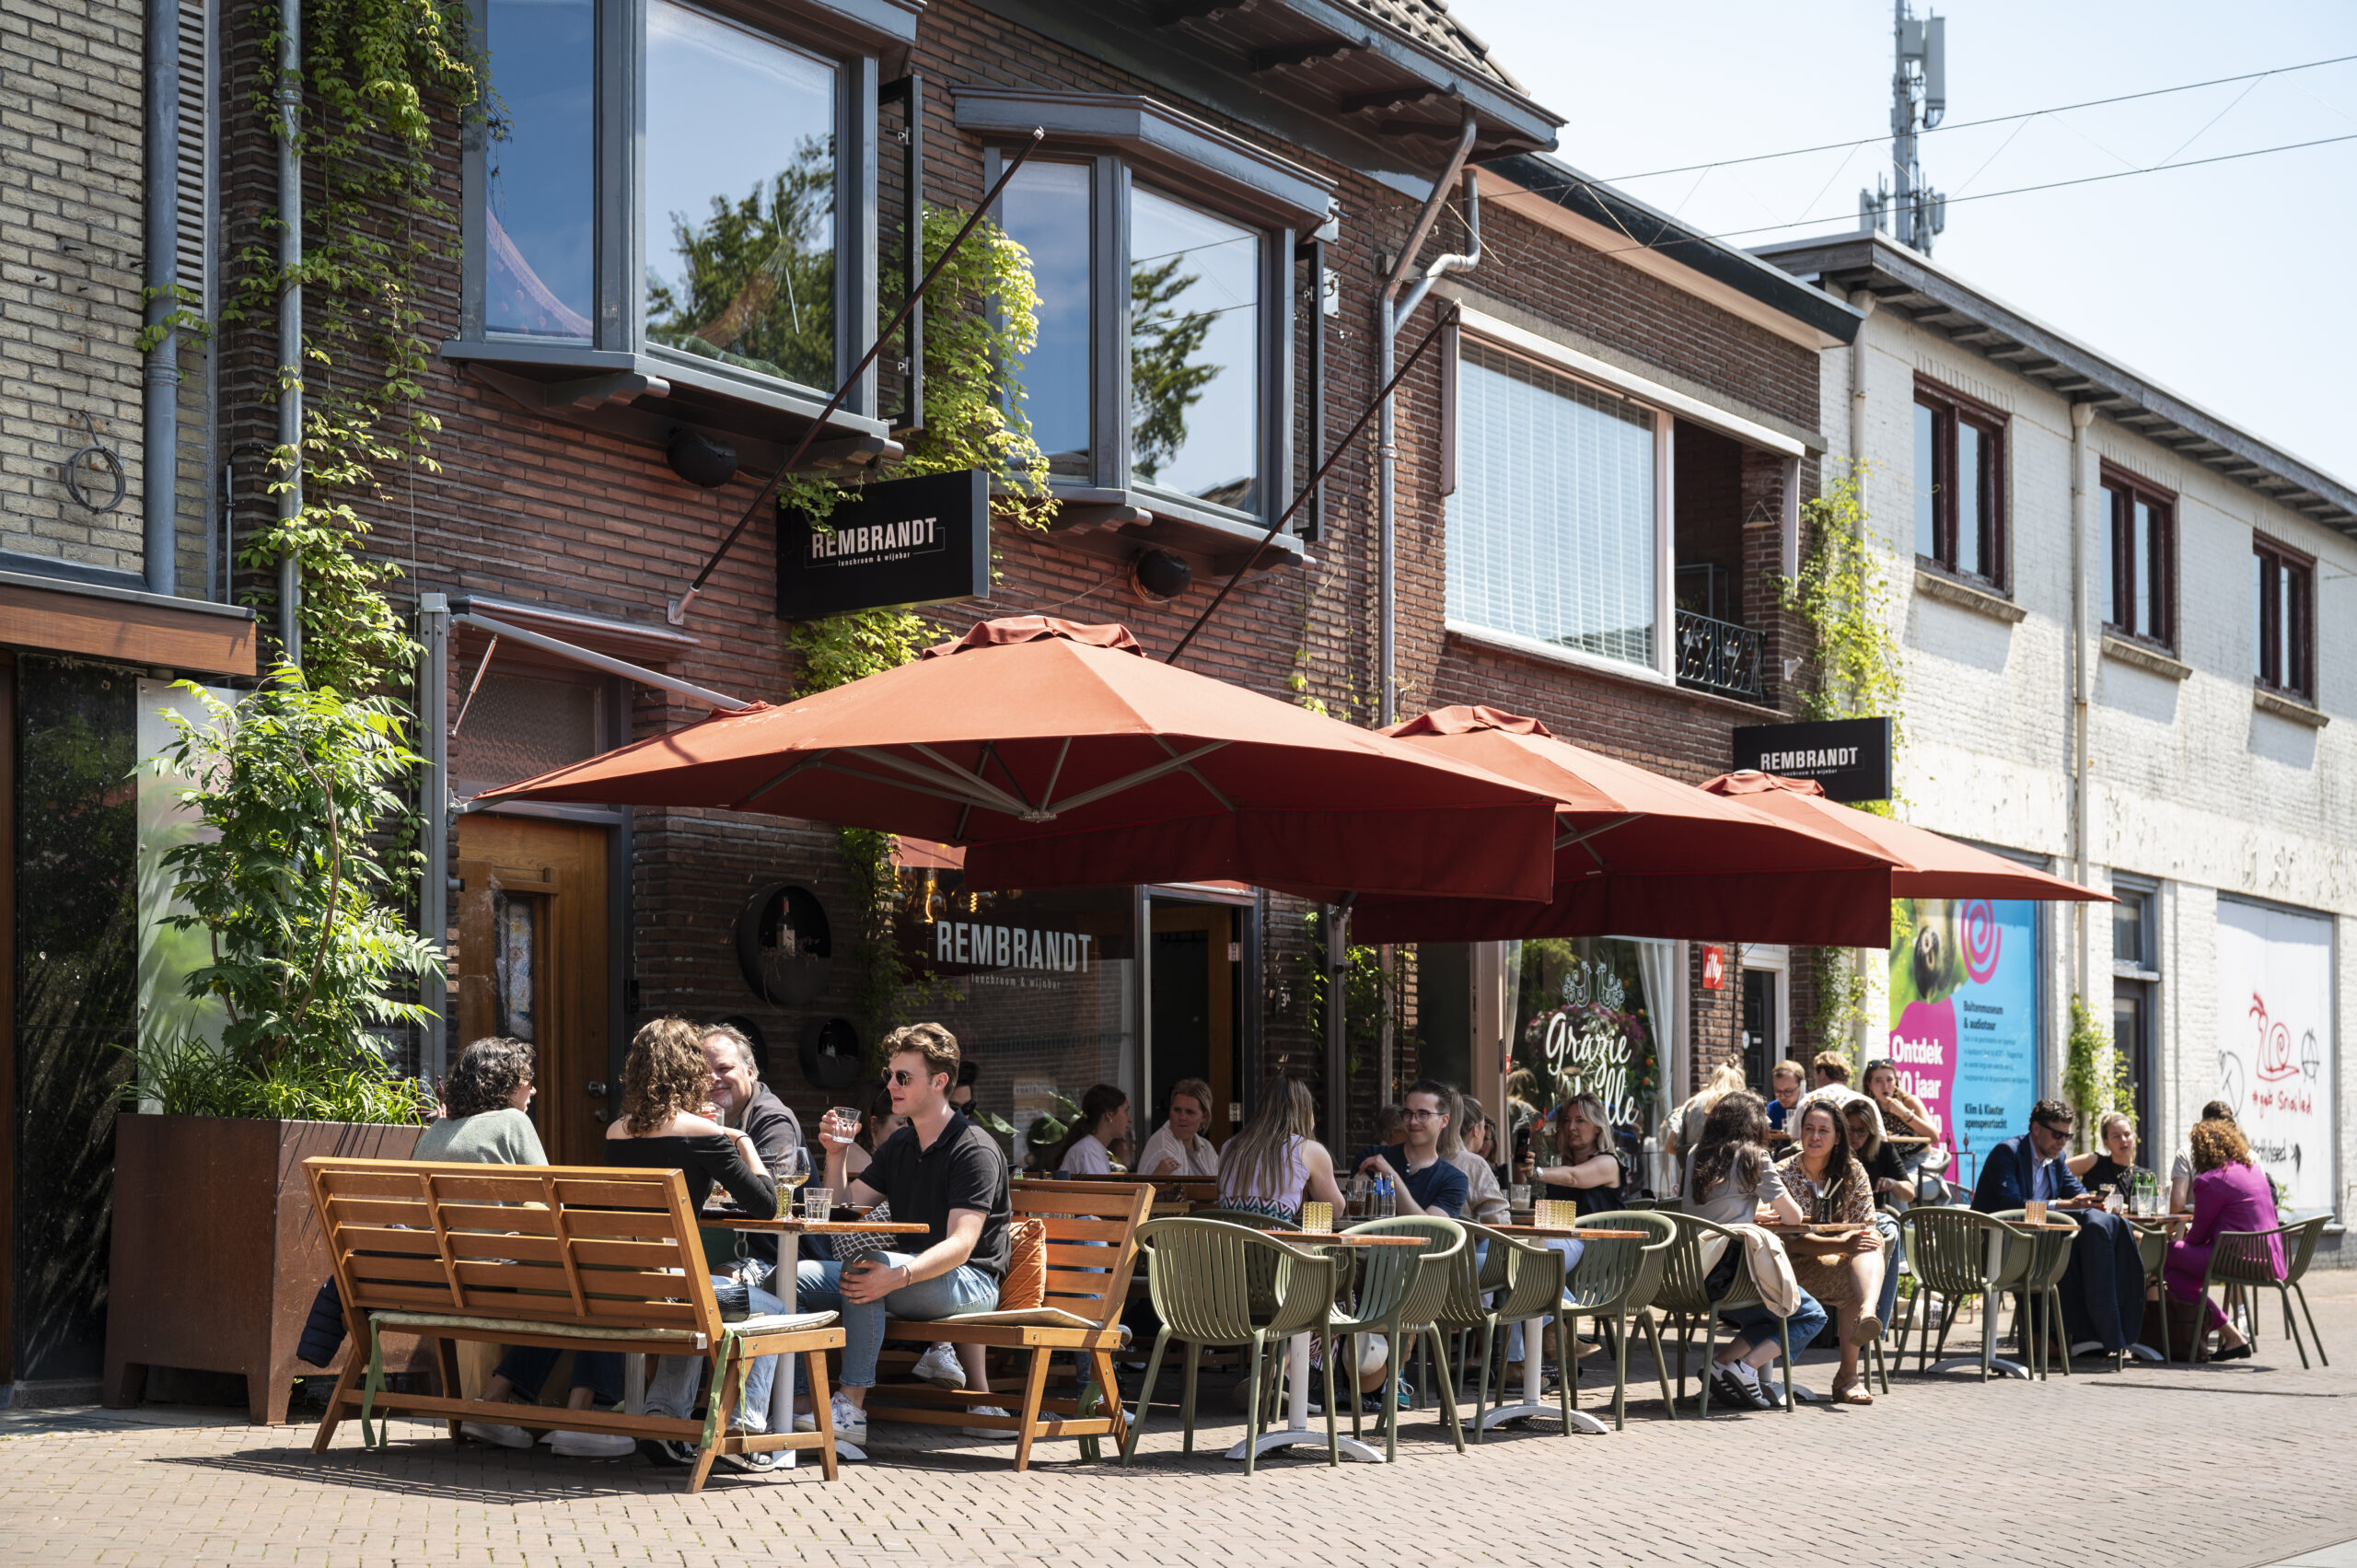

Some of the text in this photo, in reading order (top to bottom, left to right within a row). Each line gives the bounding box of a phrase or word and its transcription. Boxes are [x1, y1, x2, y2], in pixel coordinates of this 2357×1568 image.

[812, 517, 937, 559] REMBRANDT
[838, 556, 874, 567] lunchroom
[884, 552, 911, 562] wijnbar
[1760, 747, 1858, 771] REMBRANDT
[937, 921, 1092, 973] REMBRANDT
[971, 972, 1061, 990] lunchroom & wijnbar
[1705, 953, 1723, 985] illy
[1281, 993, 1291, 1007] 3A
[1892, 1035, 1944, 1065] Ontdek
[1915, 1070, 1942, 1099] jaar
